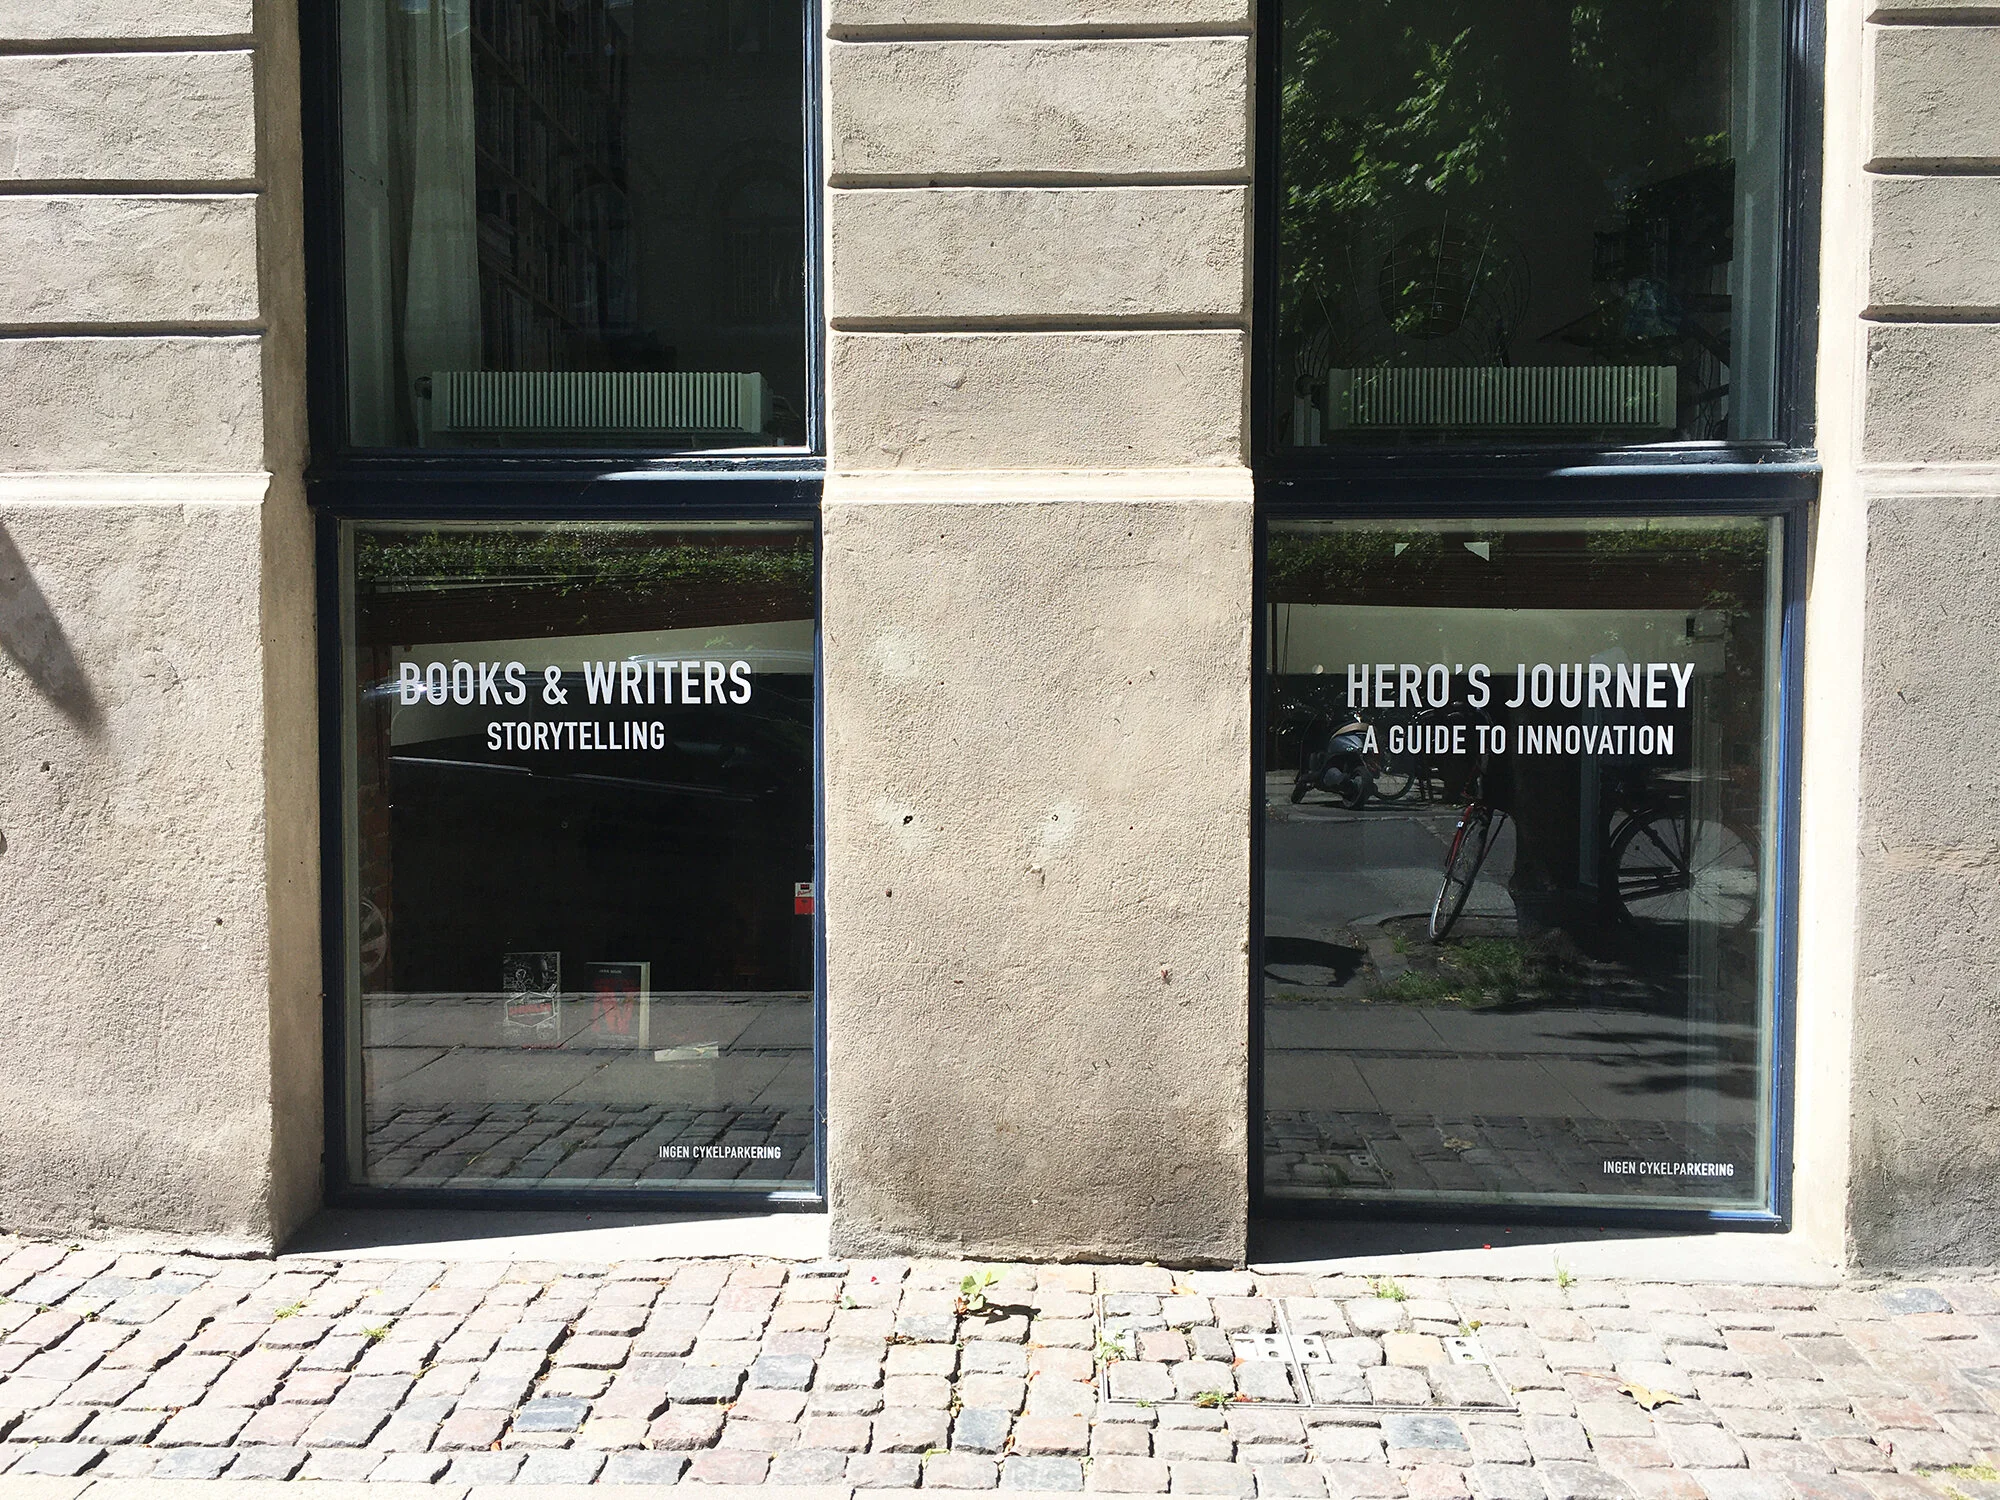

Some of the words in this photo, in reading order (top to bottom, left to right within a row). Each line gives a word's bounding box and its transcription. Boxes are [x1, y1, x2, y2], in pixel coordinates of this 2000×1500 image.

[399, 660, 526, 706] BOOKS
[543, 665, 568, 705] &
[583, 659, 753, 705] WRITERS
[1347, 662, 1491, 708] HERO'S
[1505, 662, 1695, 709] JOURNEY
[487, 721, 665, 751] STORYTELLING
[1362, 725, 1379, 754] A
[1389, 725, 1467, 755] GUIDE
[1476, 725, 1506, 755] TO
[1517, 725, 1674, 756] INNOVATION
[659, 1146, 690, 1158] INGEN
[693, 1146, 782, 1159] CYKELPARKERING
[1603, 1161, 1636, 1174] INGEN
[1639, 1162, 1734, 1176] CYKELPARKERING
